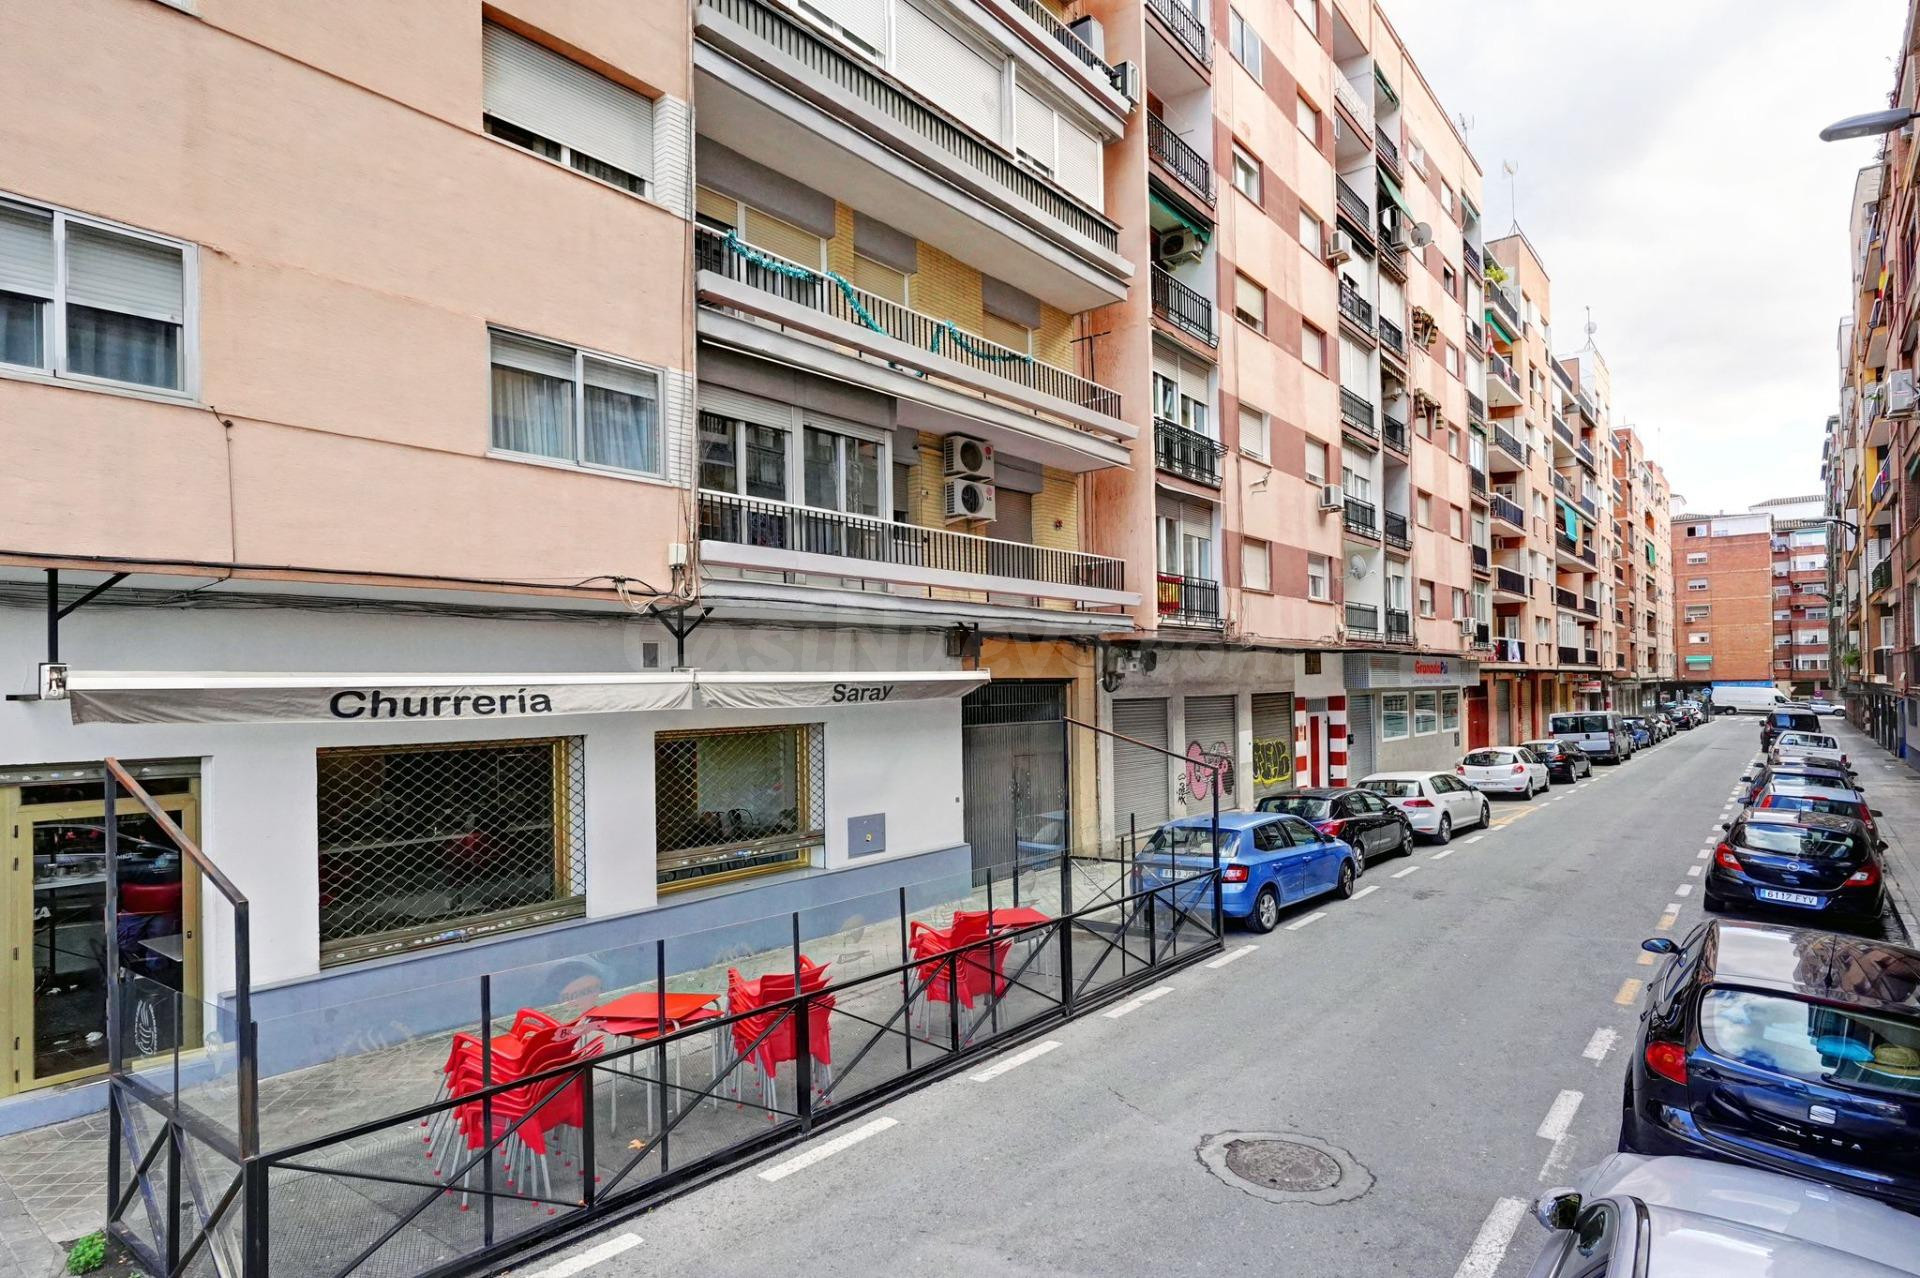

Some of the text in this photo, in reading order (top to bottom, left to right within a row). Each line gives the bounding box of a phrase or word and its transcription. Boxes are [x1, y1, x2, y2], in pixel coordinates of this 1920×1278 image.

[329, 688, 553, 718] Churrería
[832, 683, 895, 702] Saray
[1778, 1125, 1863, 1151] ALTEA
